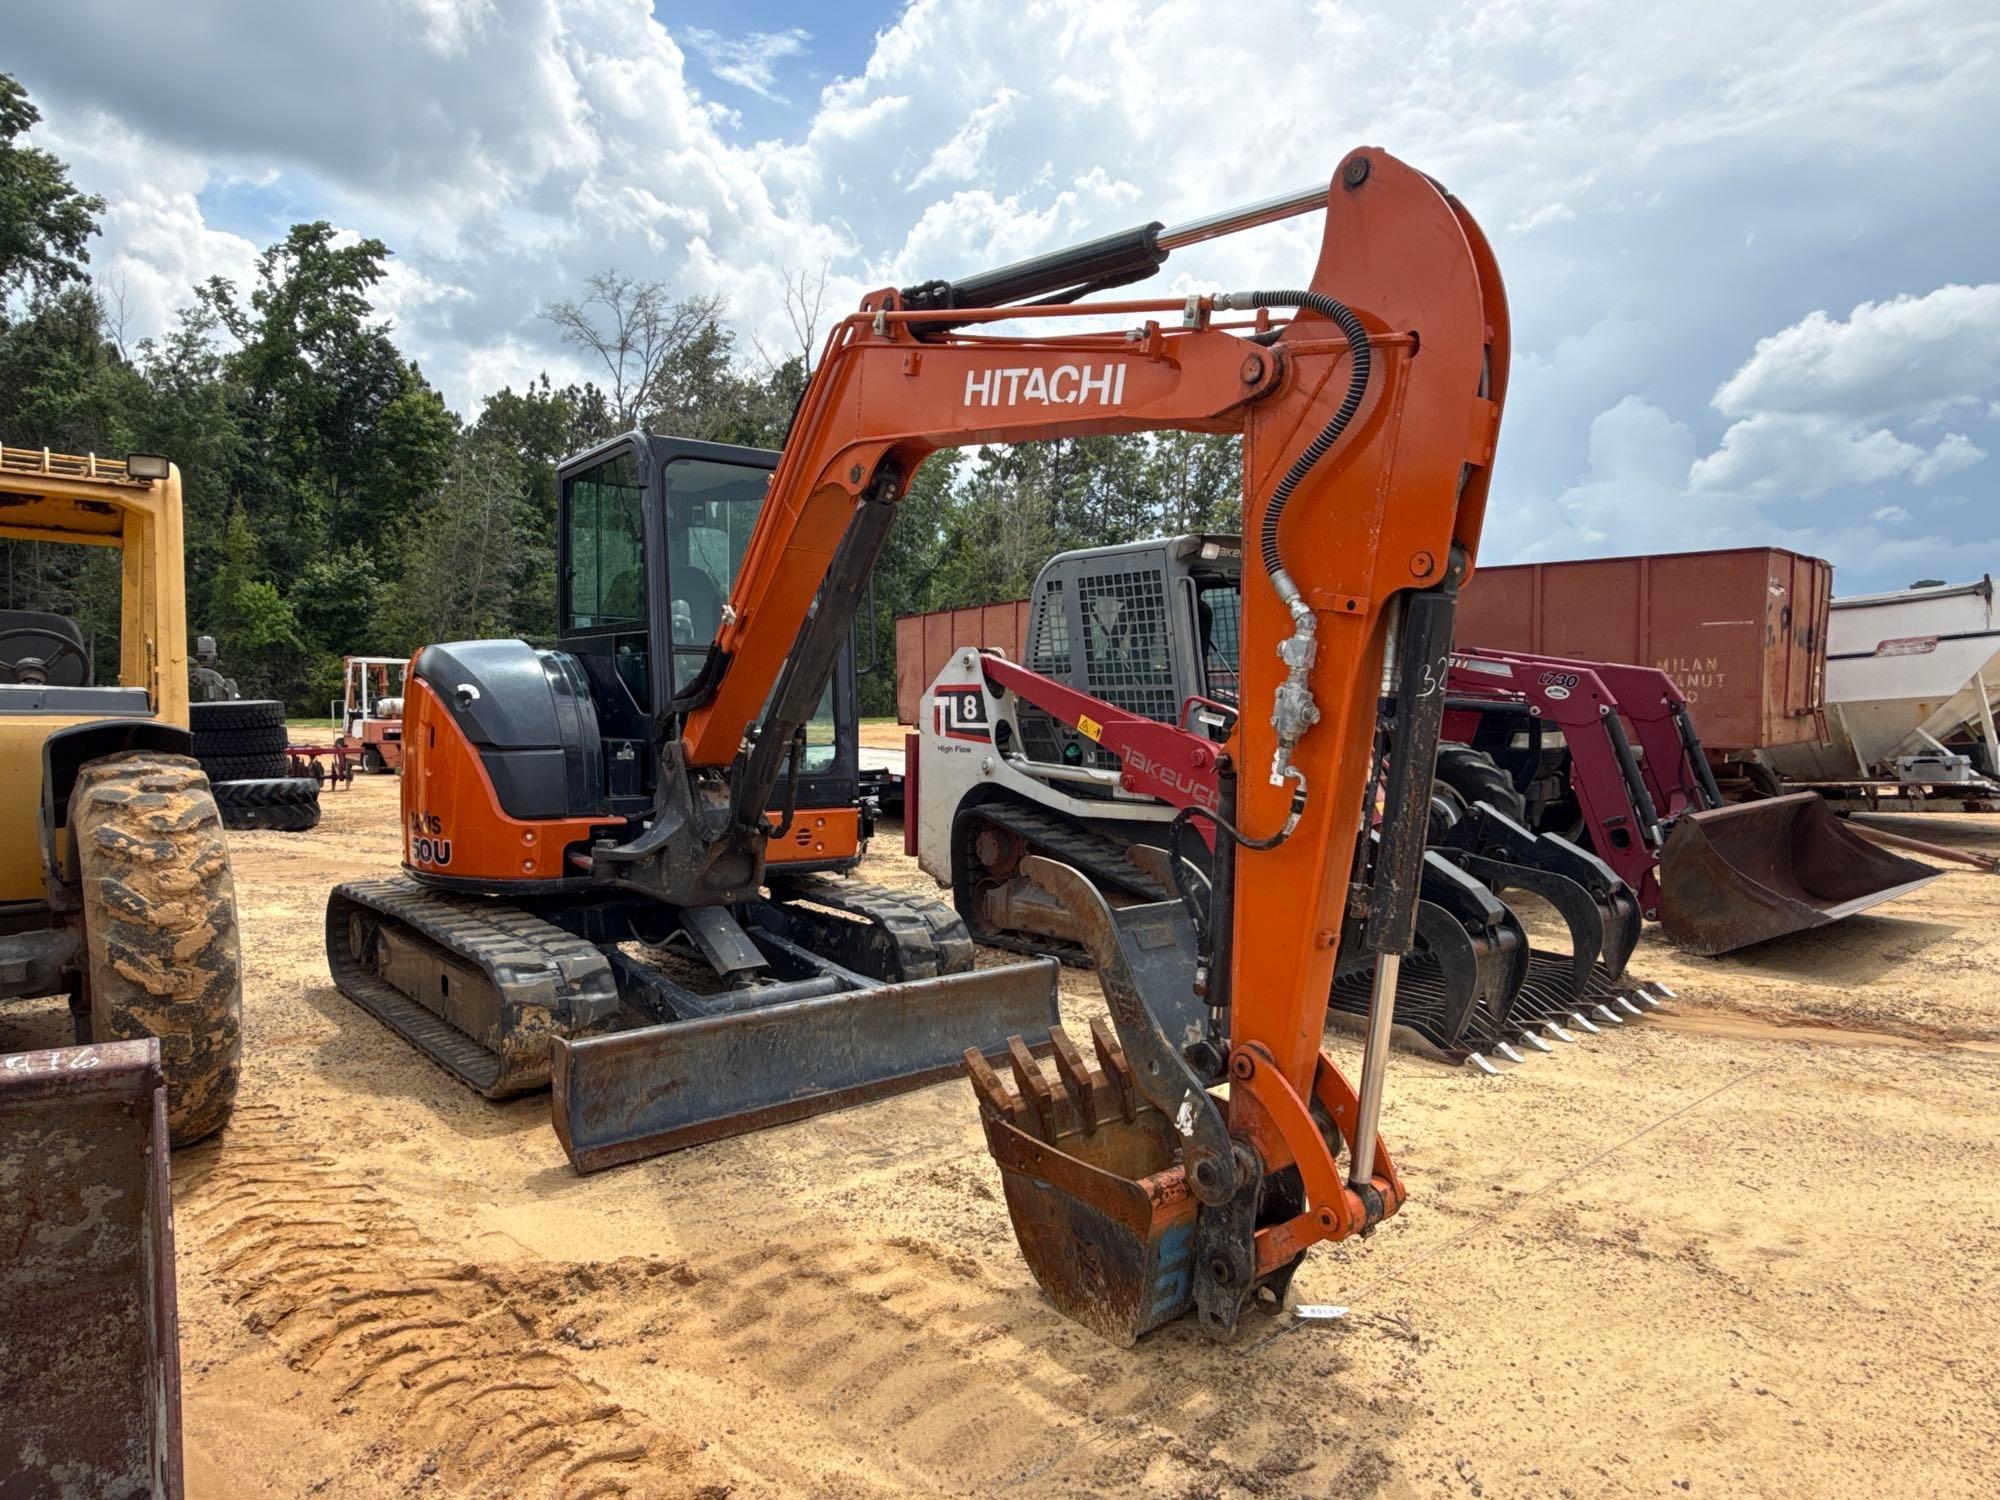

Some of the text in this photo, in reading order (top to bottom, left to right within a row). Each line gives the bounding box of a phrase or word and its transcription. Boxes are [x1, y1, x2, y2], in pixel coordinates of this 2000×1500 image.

[963, 363, 1127, 407] HITACHI
[1657, 657, 1719, 673] MILAN
[1537, 671, 1580, 688] L730
[937, 744, 972, 755] High Flow
